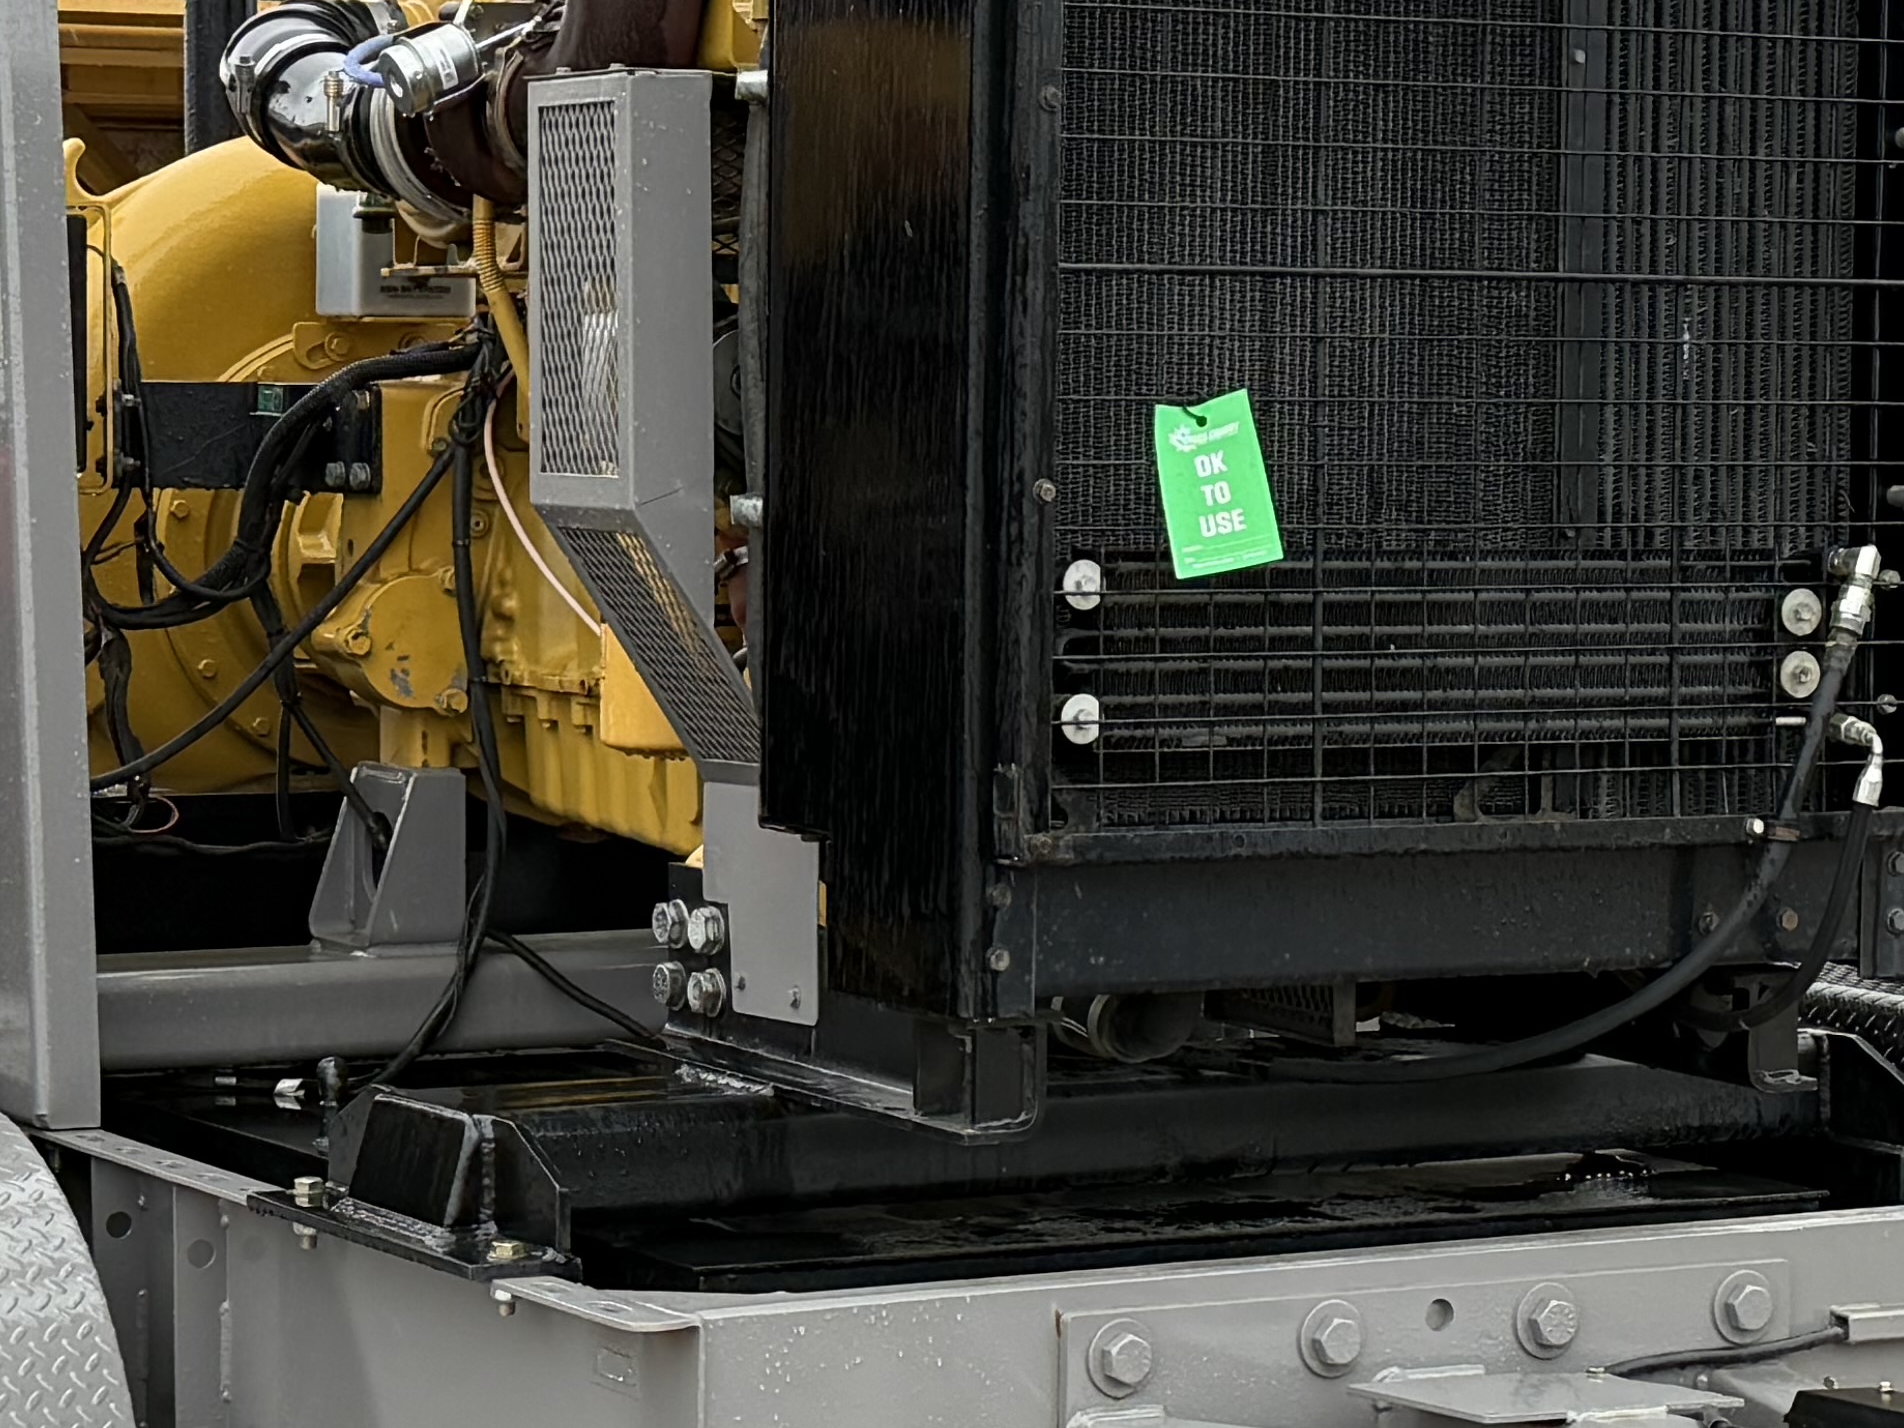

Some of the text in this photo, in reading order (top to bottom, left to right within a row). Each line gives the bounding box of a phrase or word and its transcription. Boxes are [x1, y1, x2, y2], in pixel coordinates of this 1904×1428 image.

[1194, 450, 1228, 478] OK
[1200, 481, 1232, 507] TO
[1198, 508, 1247, 538] USE
